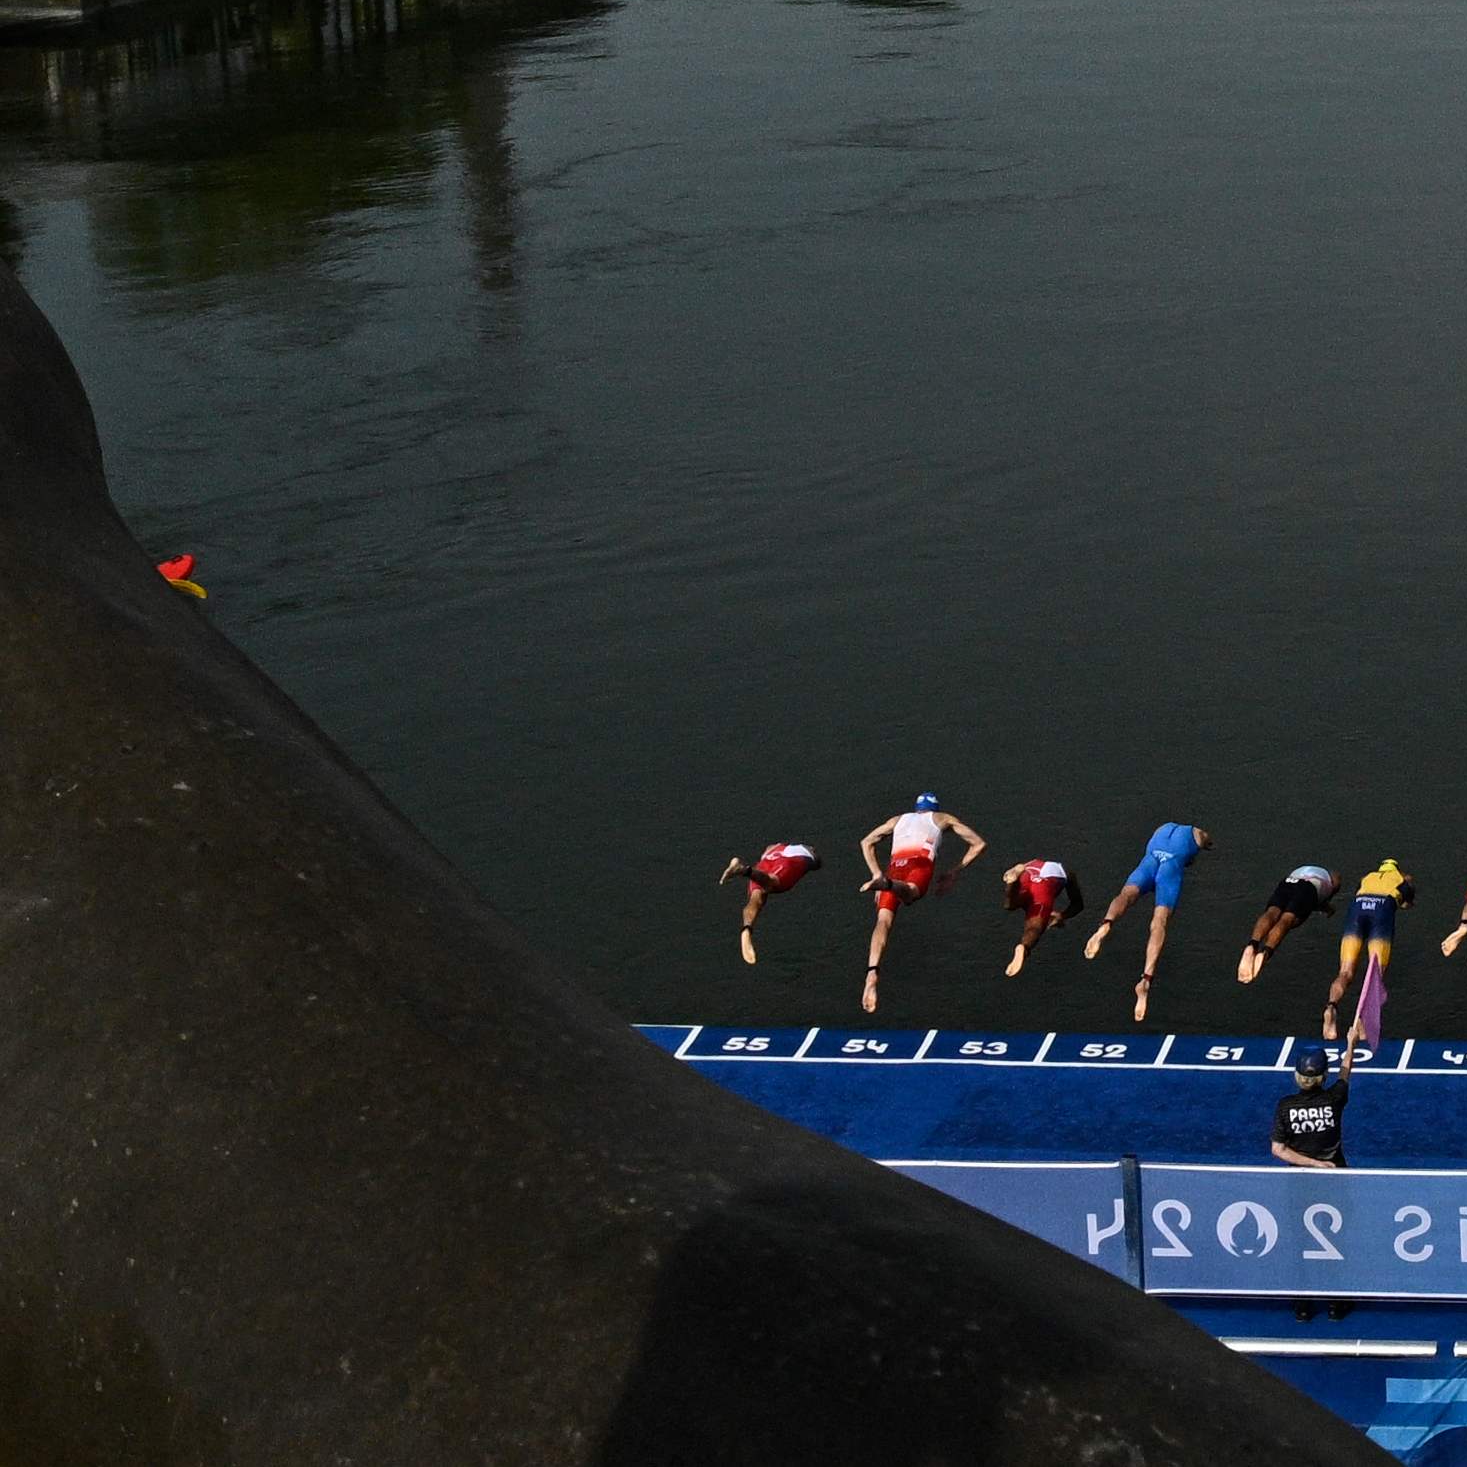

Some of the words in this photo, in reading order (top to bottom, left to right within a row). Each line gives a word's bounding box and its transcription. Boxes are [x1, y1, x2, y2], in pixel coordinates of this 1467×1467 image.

[721, 1036, 771, 1052] 55
[840, 1038, 889, 1054] 54
[958, 1040, 1008, 1056] 53
[1079, 1043, 1128, 1059] 52
[1205, 1045, 1245, 1061] 51
[1289, 1106, 1333, 1122] PARIS
[1291, 1119, 1335, 1134] 2024
